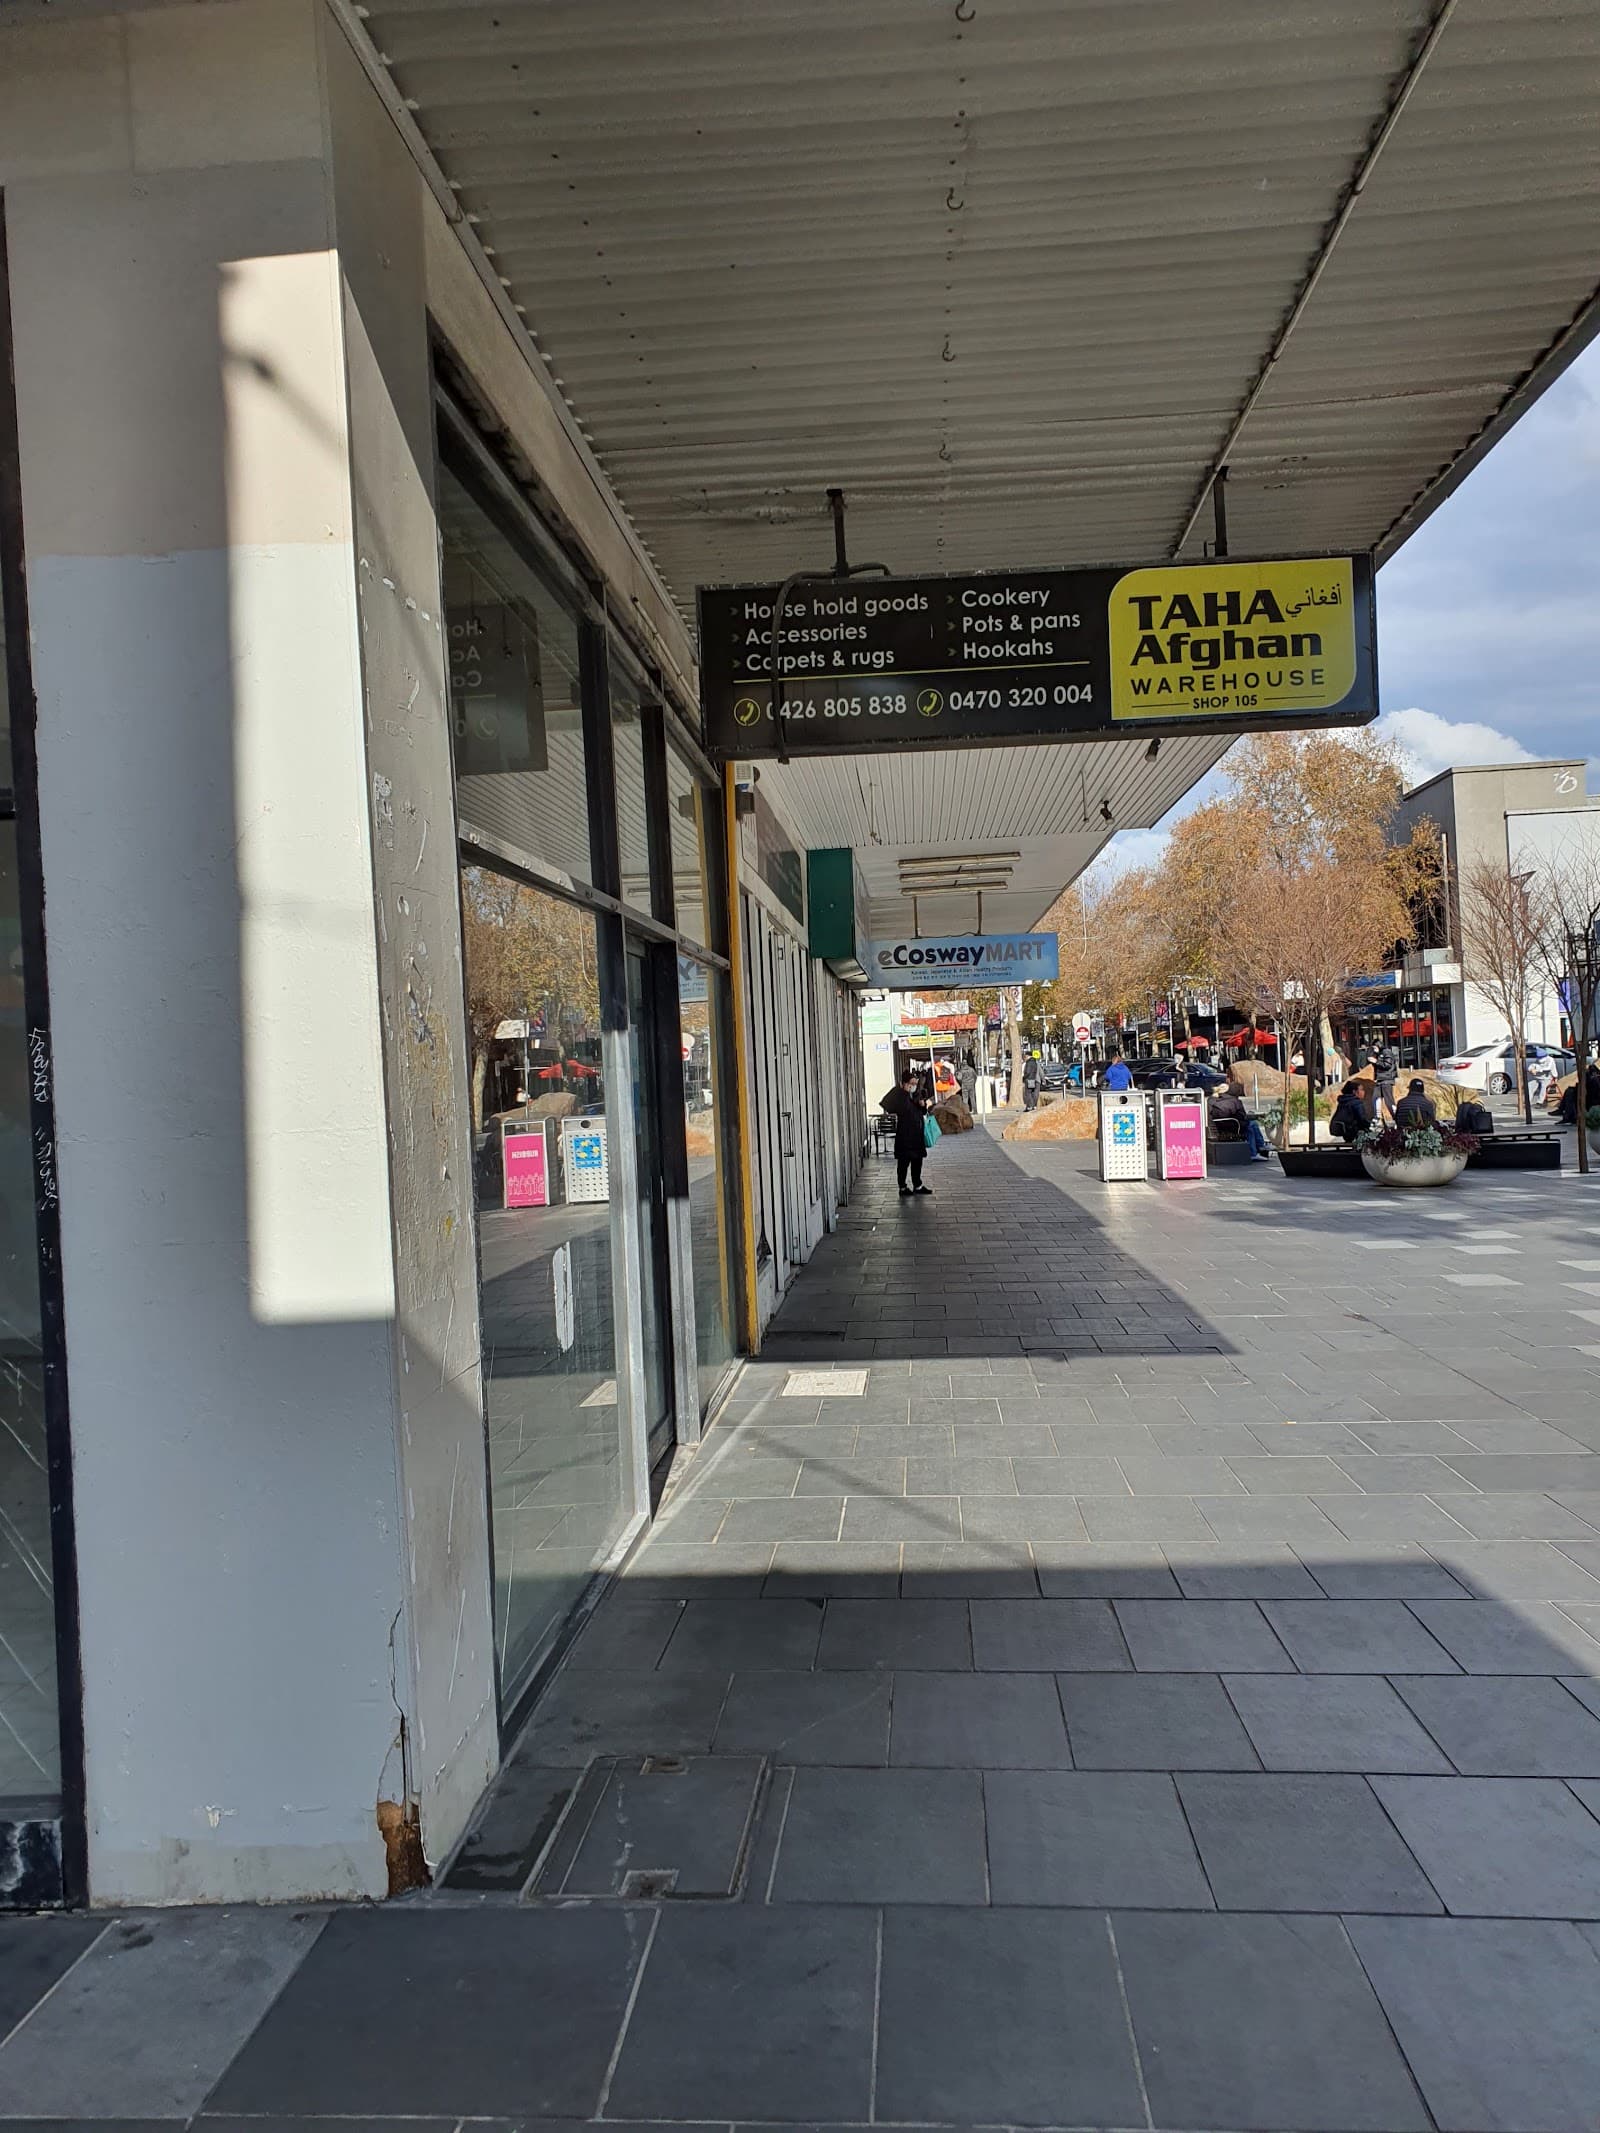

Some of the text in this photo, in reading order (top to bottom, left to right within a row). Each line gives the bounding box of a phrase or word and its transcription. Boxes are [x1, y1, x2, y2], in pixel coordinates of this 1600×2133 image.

[813, 597, 857, 615] hold
[864, 593, 928, 616] goods
[961, 588, 1050, 608] Cookery
[1128, 589, 1285, 630] TAHA
[745, 623, 867, 645] Accessories
[962, 612, 1081, 634] Pots & pans
[746, 650, 895, 673] Carpets & rugs
[963, 640, 1054, 660] Hookahs
[1130, 630, 1322, 671] Afghan
[1131, 668, 1324, 695] WAREHOUSE
[823, 698, 862, 718] 805
[868, 695, 907, 715] 838
[949, 684, 1093, 711] 0470 320 004
[1193, 695, 1257, 709] SHOP 105
